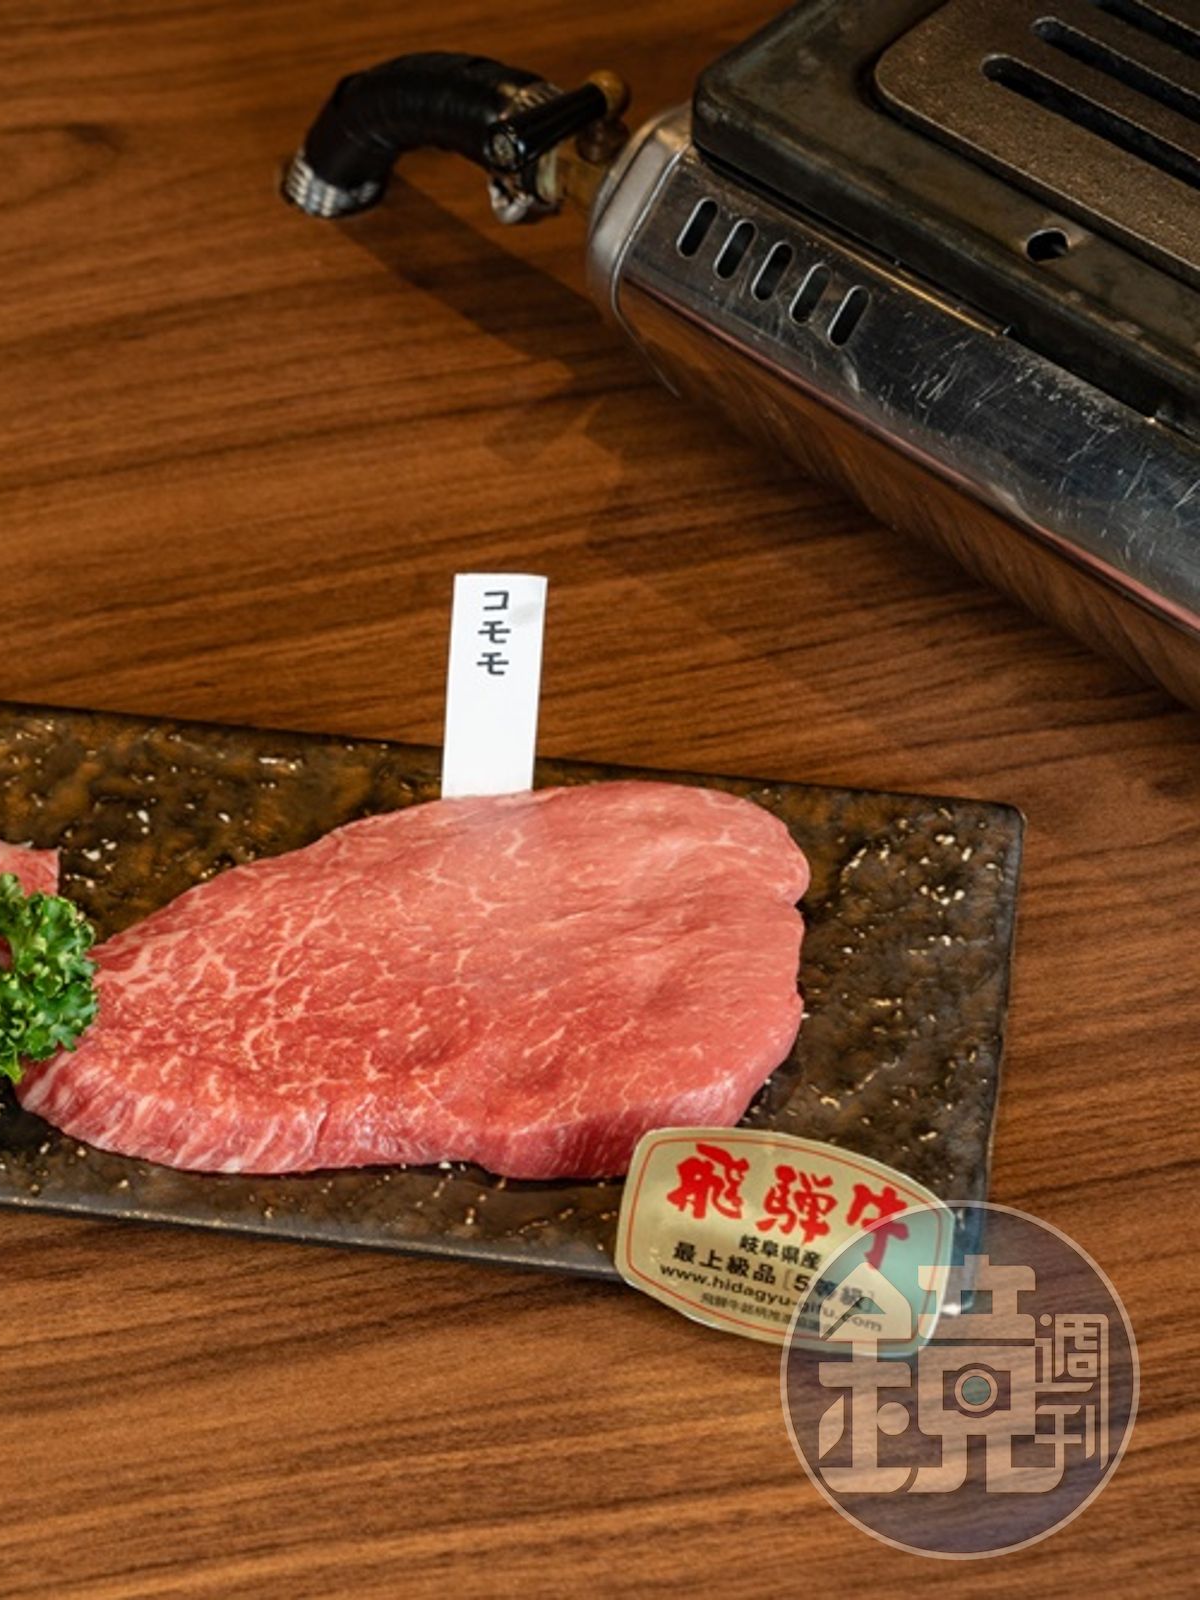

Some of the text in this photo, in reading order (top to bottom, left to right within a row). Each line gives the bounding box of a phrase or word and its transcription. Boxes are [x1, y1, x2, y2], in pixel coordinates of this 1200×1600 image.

[476, 590, 511, 676] コモモ
[667, 1143, 909, 1270] 飛騨牛
[739, 1234, 820, 1271] 岐阜県産
